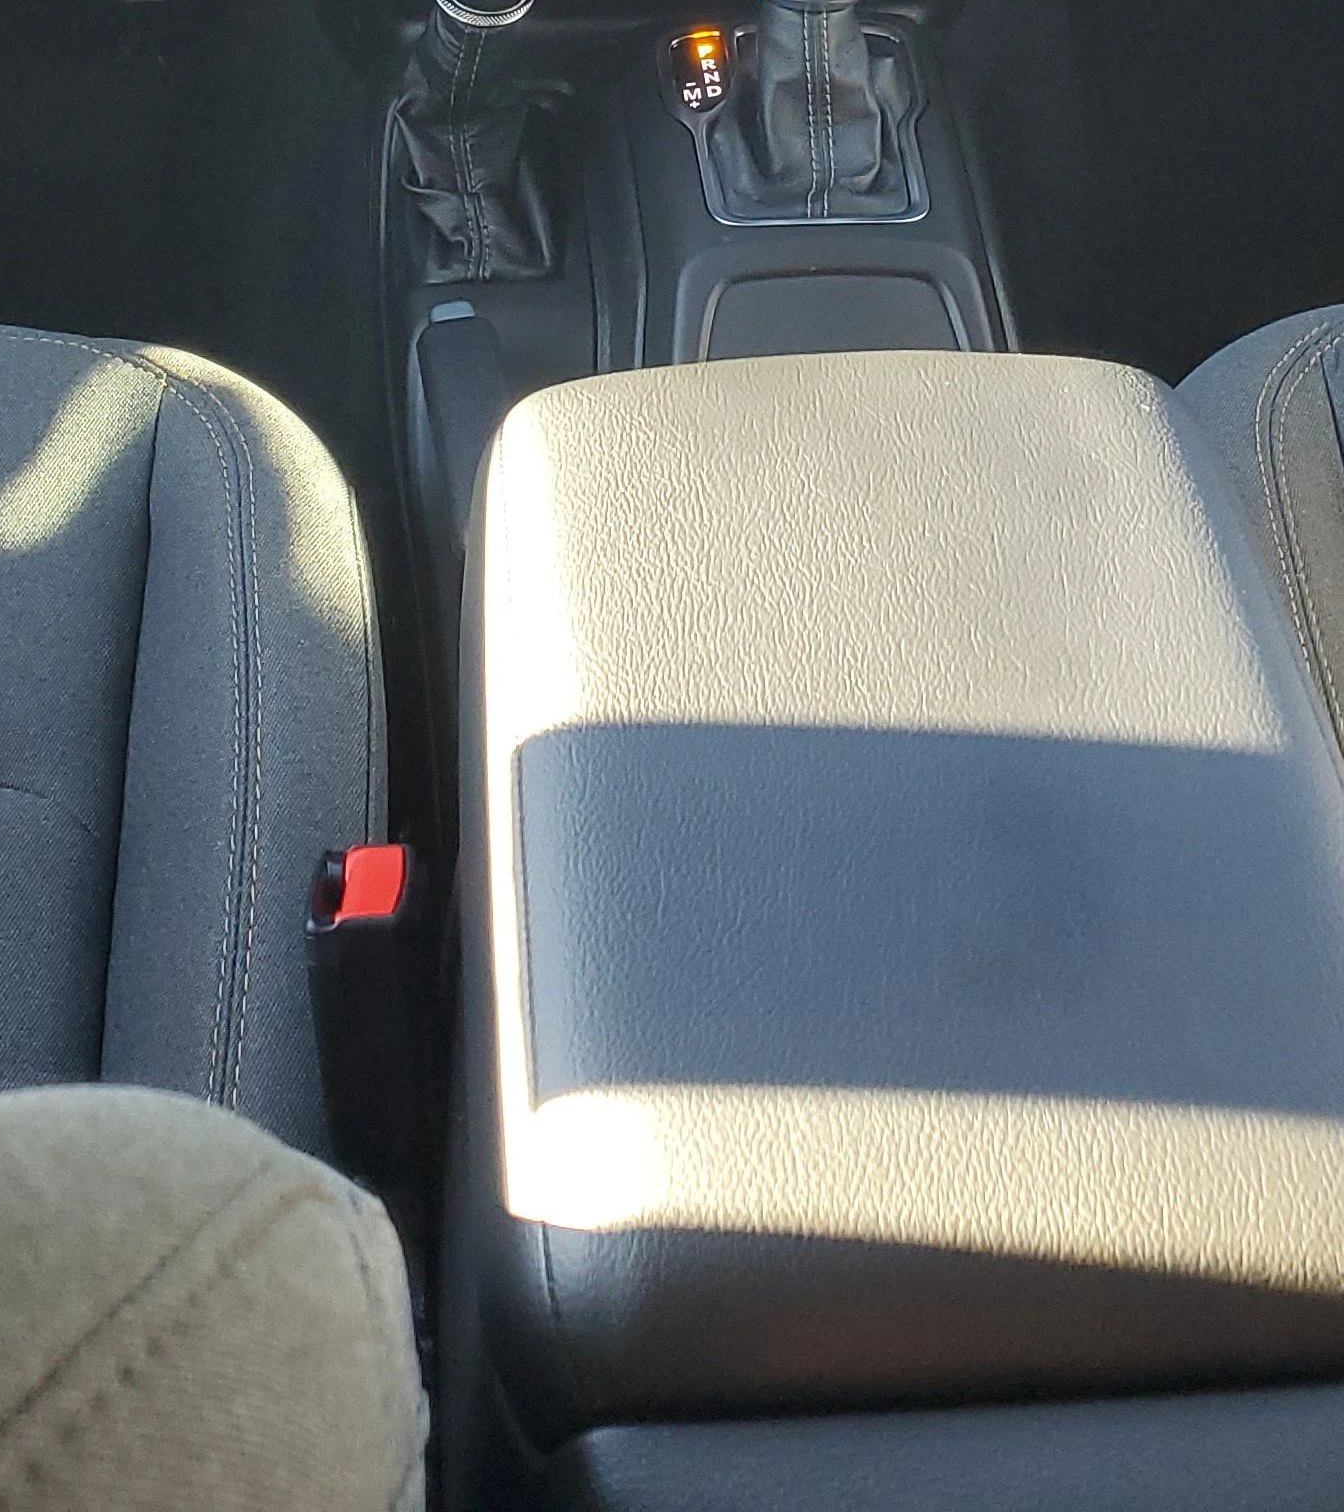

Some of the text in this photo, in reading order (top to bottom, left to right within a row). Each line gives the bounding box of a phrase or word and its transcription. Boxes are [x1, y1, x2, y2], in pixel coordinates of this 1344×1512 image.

[701, 59, 717, 70] R
[703, 71, 721, 84] N
[683, 88, 702, 101] M
[706, 85, 722, 98] D
